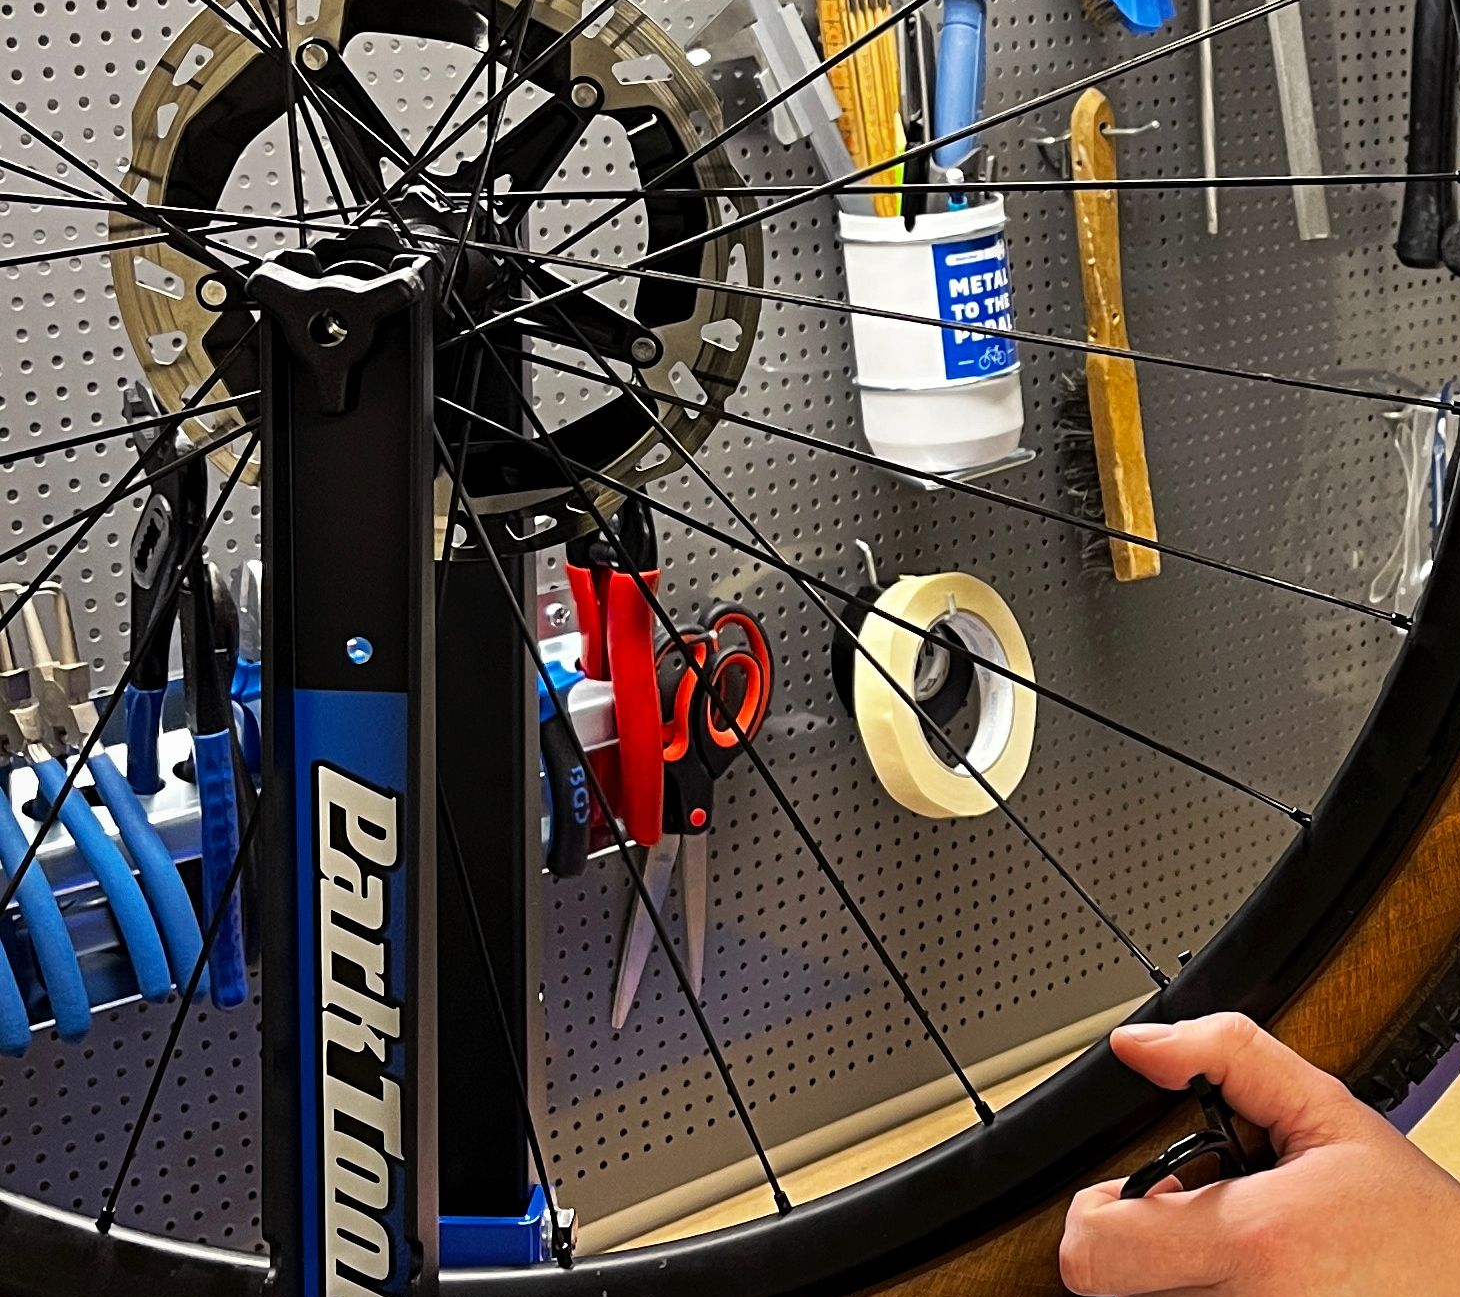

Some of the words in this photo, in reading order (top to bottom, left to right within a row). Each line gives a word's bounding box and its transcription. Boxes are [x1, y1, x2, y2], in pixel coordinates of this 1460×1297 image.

[949, 267, 1008, 298] METAL
[951, 301, 980, 321] TO
[984, 293, 1010, 314] THE
